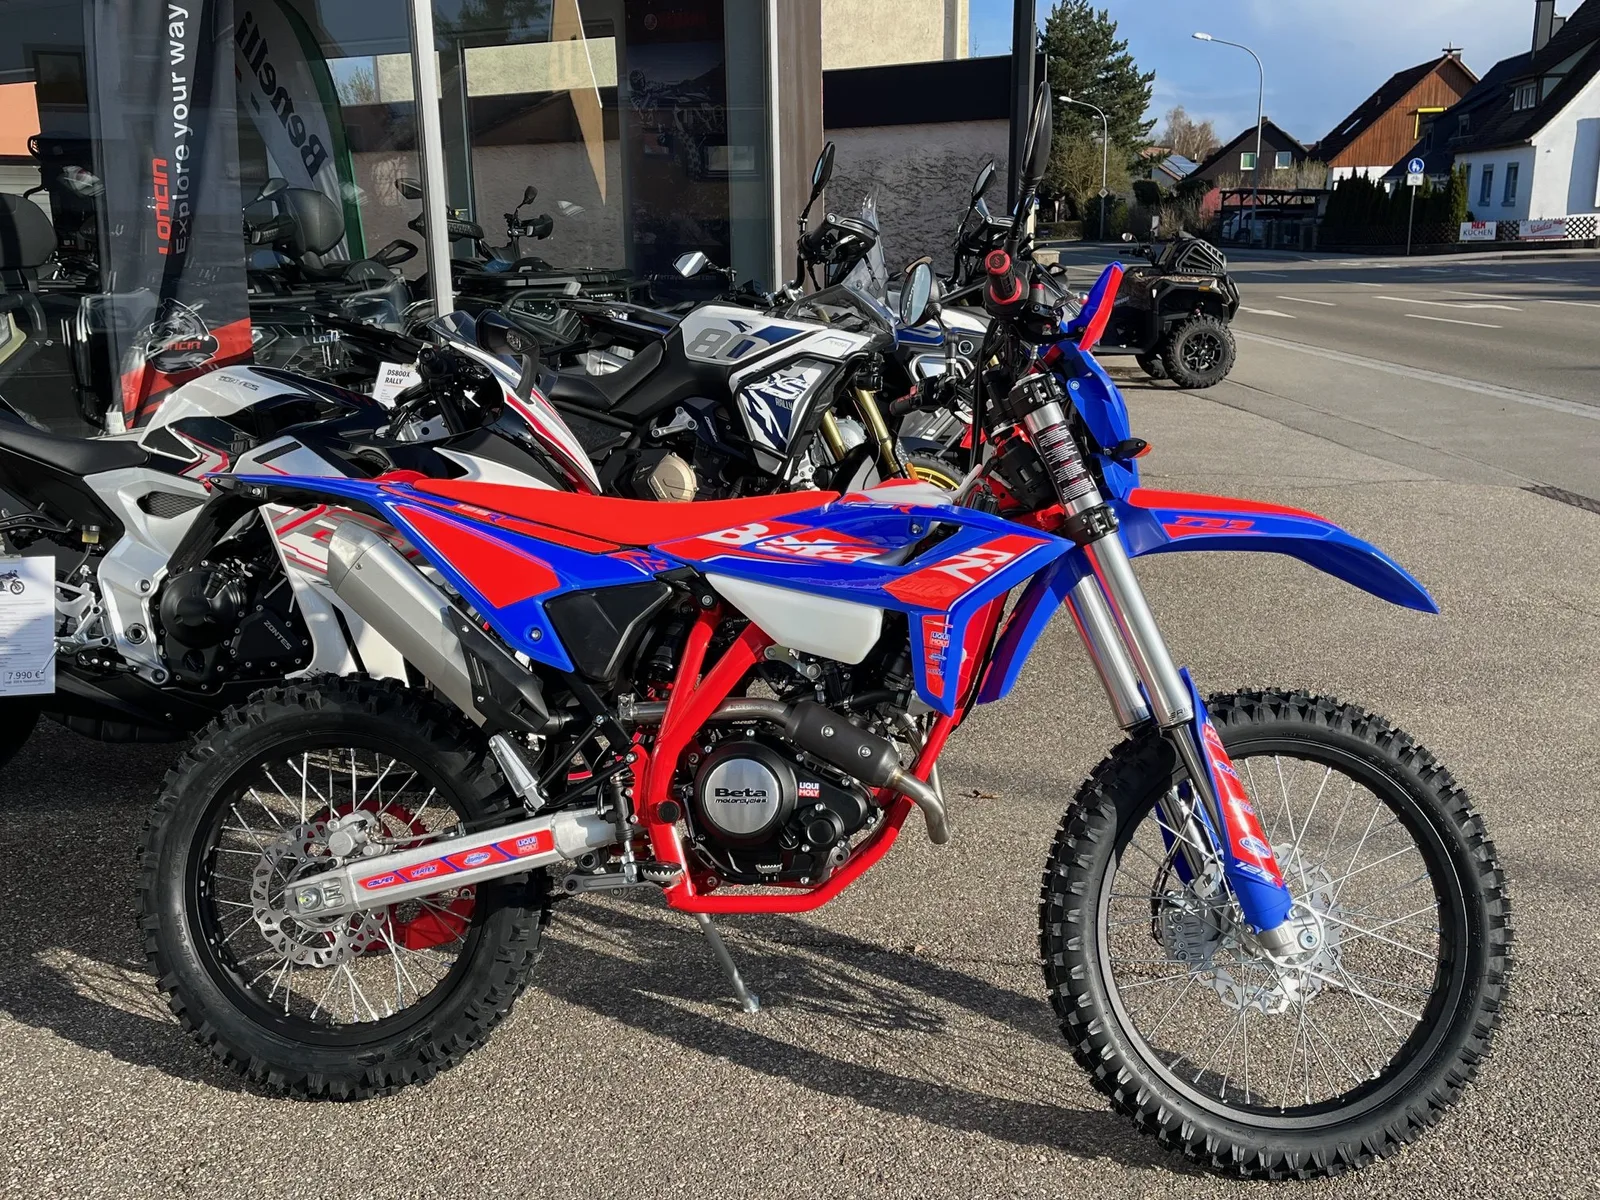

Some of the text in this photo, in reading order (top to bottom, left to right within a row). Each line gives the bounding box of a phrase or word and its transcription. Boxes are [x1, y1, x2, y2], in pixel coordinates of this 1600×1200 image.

[168, 3, 188, 66] way
[171, 72, 193, 138] your
[387, 369, 410, 378] DS800X
[384, 377, 404, 385] RALLY
[263, 620, 292, 650] ZONTES
[8, 671, 32, 680] 7.990
[799, 782, 820, 790] LIQUI
[714, 788, 767, 797] Beta
[516, 837, 538, 847] LIQUI
[518, 844, 539, 854] MOLY
[411, 865, 437, 878] VERTEX
